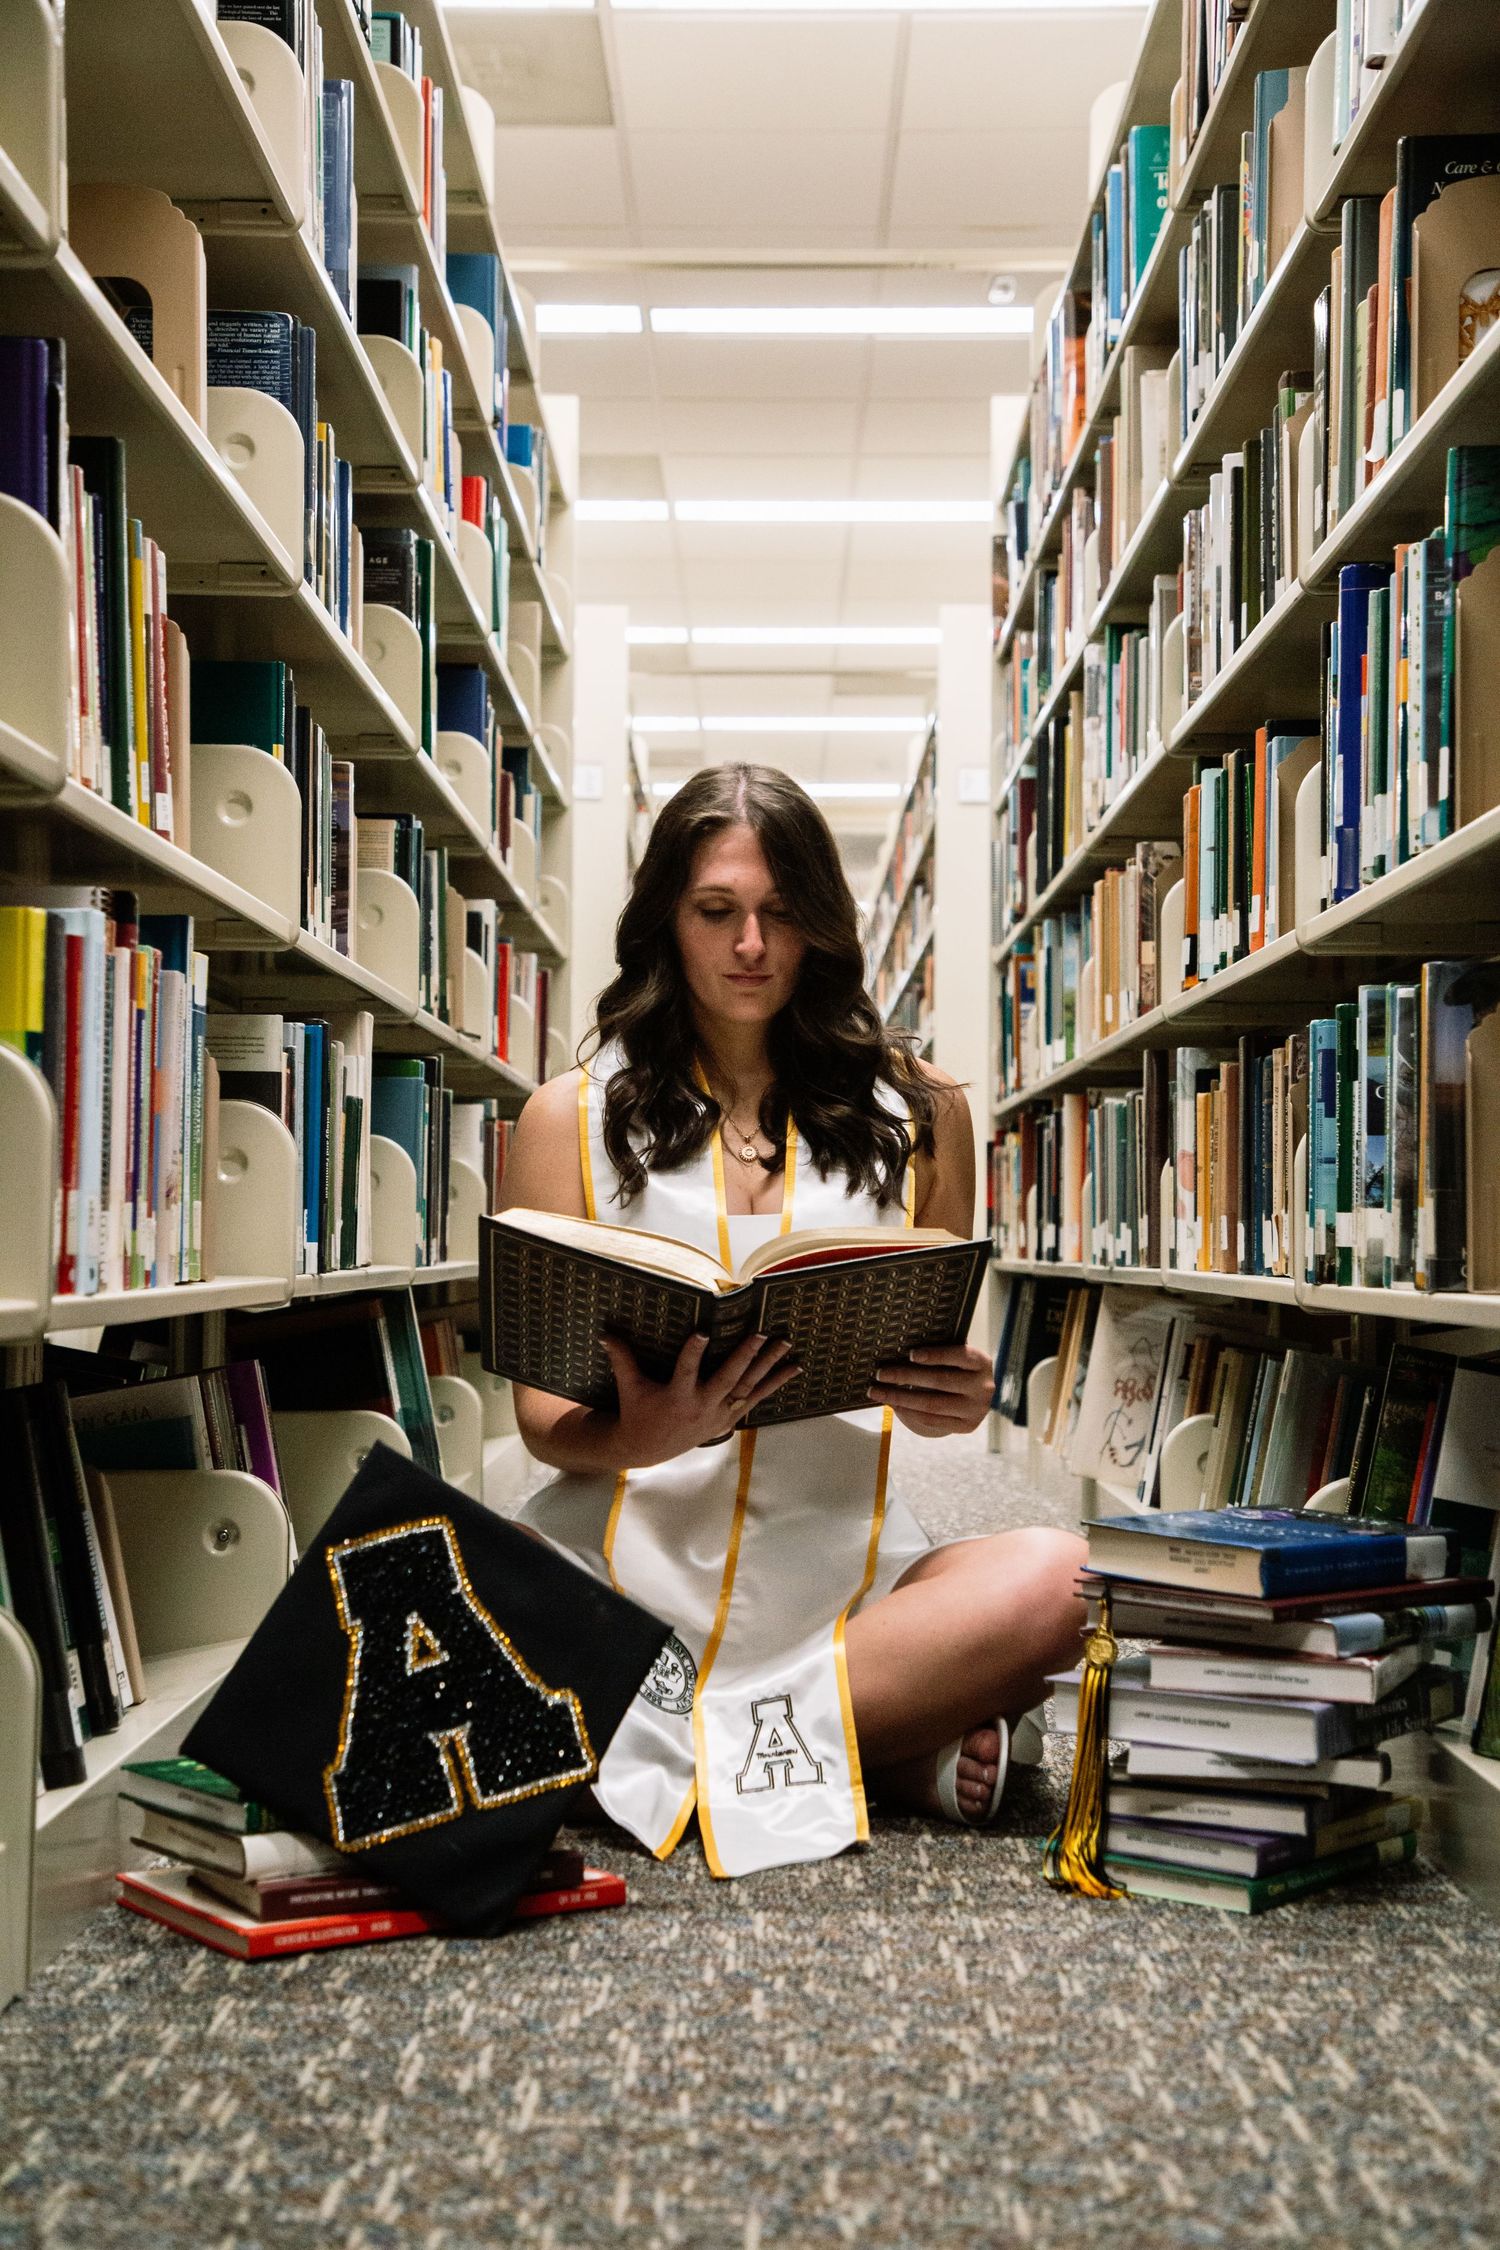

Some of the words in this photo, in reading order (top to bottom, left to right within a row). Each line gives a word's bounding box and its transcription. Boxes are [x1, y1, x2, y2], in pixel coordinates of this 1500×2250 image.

[1445, 160, 1478, 175] Care
[1481, 160, 1493, 174] &
[322, 1514, 599, 1854] A
[736, 1694, 824, 1794] A
